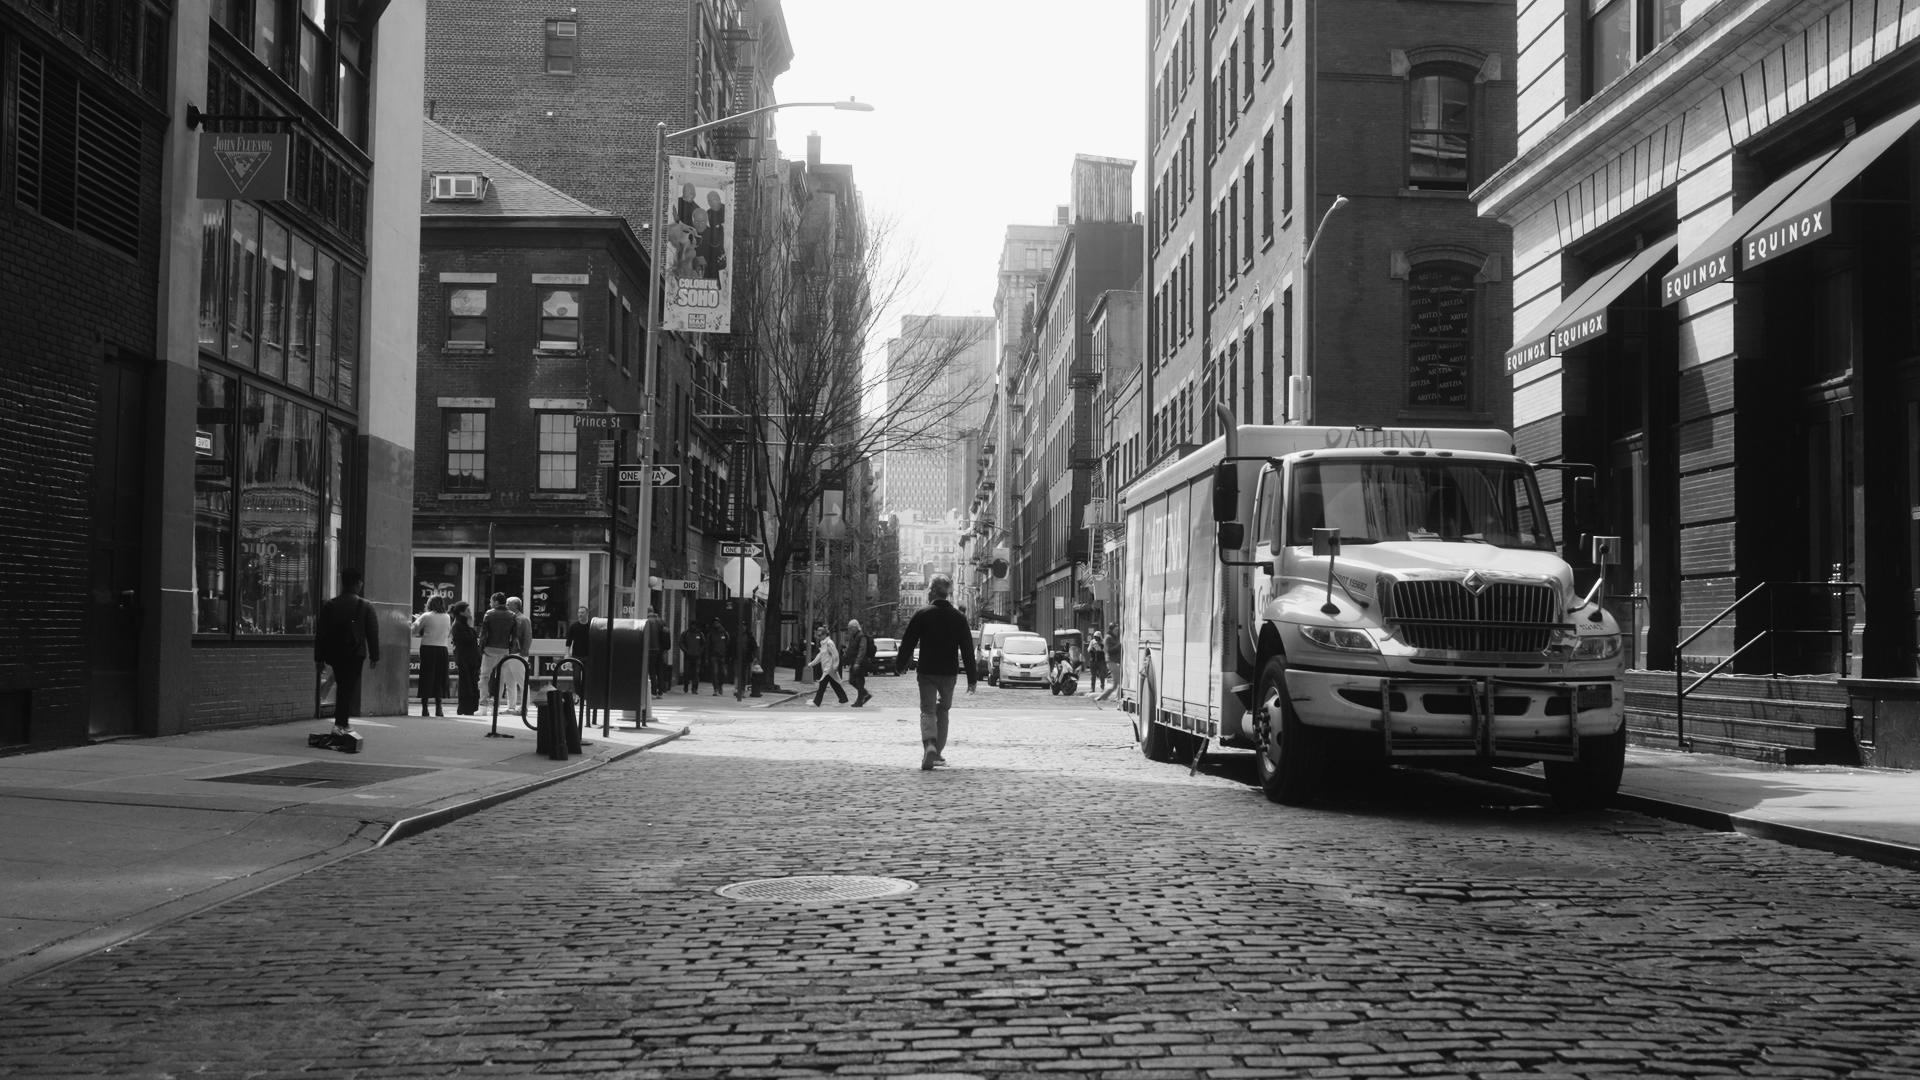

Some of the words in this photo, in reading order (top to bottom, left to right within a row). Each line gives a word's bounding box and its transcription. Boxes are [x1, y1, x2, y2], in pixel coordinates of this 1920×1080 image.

[213, 136, 235, 151] JOHN
[236, 136, 273, 152] FLUEVOG
[1748, 210, 1825, 262] EQUINOX
[678, 278, 718, 290] COLORFUL
[1666, 256, 1728, 299] EQUINOX
[678, 288, 719, 308] SOHO
[1439, 298, 1464, 307] ARITZIA
[1557, 313, 1604, 348] EQUINOX
[1506, 341, 1546, 371] EQUINOX
[1439, 380, 1463, 389] ARITZIA
[575, 416, 607, 428] Prince
[611, 417, 621, 428] St
[1345, 429, 1432, 448] ATHENA
[621, 472, 639, 480] ONE
[683, 581, 698, 590] DIG.
